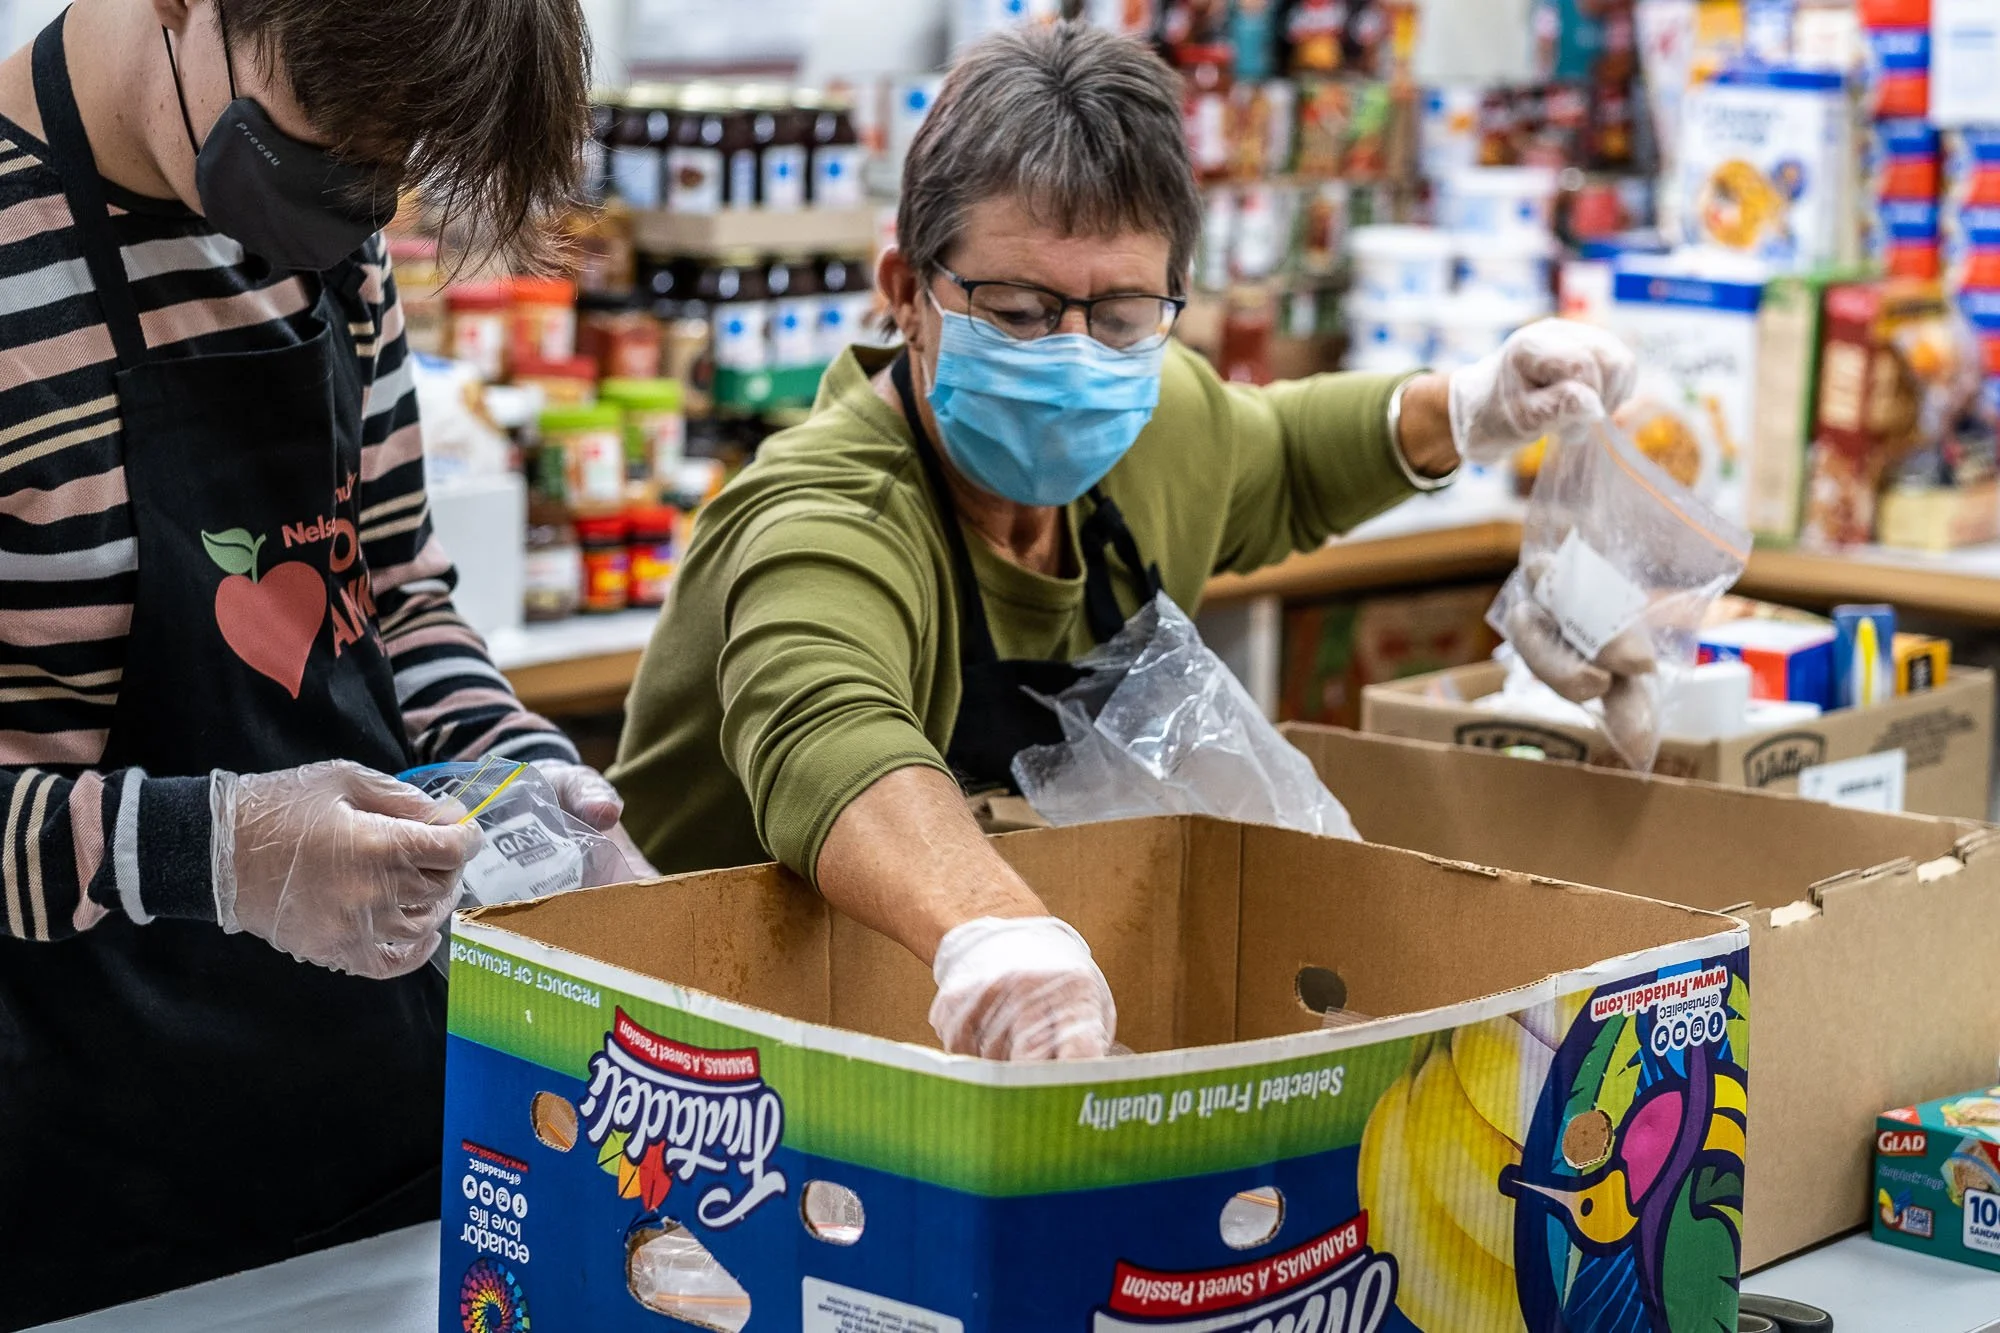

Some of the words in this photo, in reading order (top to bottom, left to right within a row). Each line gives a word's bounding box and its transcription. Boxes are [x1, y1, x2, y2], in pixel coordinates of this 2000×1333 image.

[513, 965, 533, 985] OF
[535, 971, 601, 1008] PRODUCT
[1594, 969, 1727, 1016] www.Frutadeli.com
[1659, 993, 1719, 1020] @FrutadeliEC
[619, 1020, 659, 1058] Passion
[658, 1042, 692, 1070] Sweet
[692, 1054, 701, 1073] A
[700, 1052, 755, 1076] BANANAS,
[1198, 1081, 1253, 1119] Fruit
[1257, 1065, 1345, 1110] Selected
[1077, 1091, 1164, 1131] Quality
[1167, 1088, 1194, 1124] of
[579, 1057, 787, 1228] Frutadeli
[1877, 1131, 1926, 1153] GLAD
[468, 1158, 522, 1186] @FrutadeliEC
[469, 1205, 489, 1230] life
[1969, 1195, 2000, 1228] 10
[491, 1213, 521, 1242] love
[1969, 1226, 2000, 1242] SANDW
[460, 1223, 530, 1264] ecuador
[1272, 1224, 1358, 1284] BANANAS,
[1121, 1274, 1195, 1306] Passion
[1197, 1273, 1254, 1299] Sweet
[1258, 1267, 1271, 1292] A
